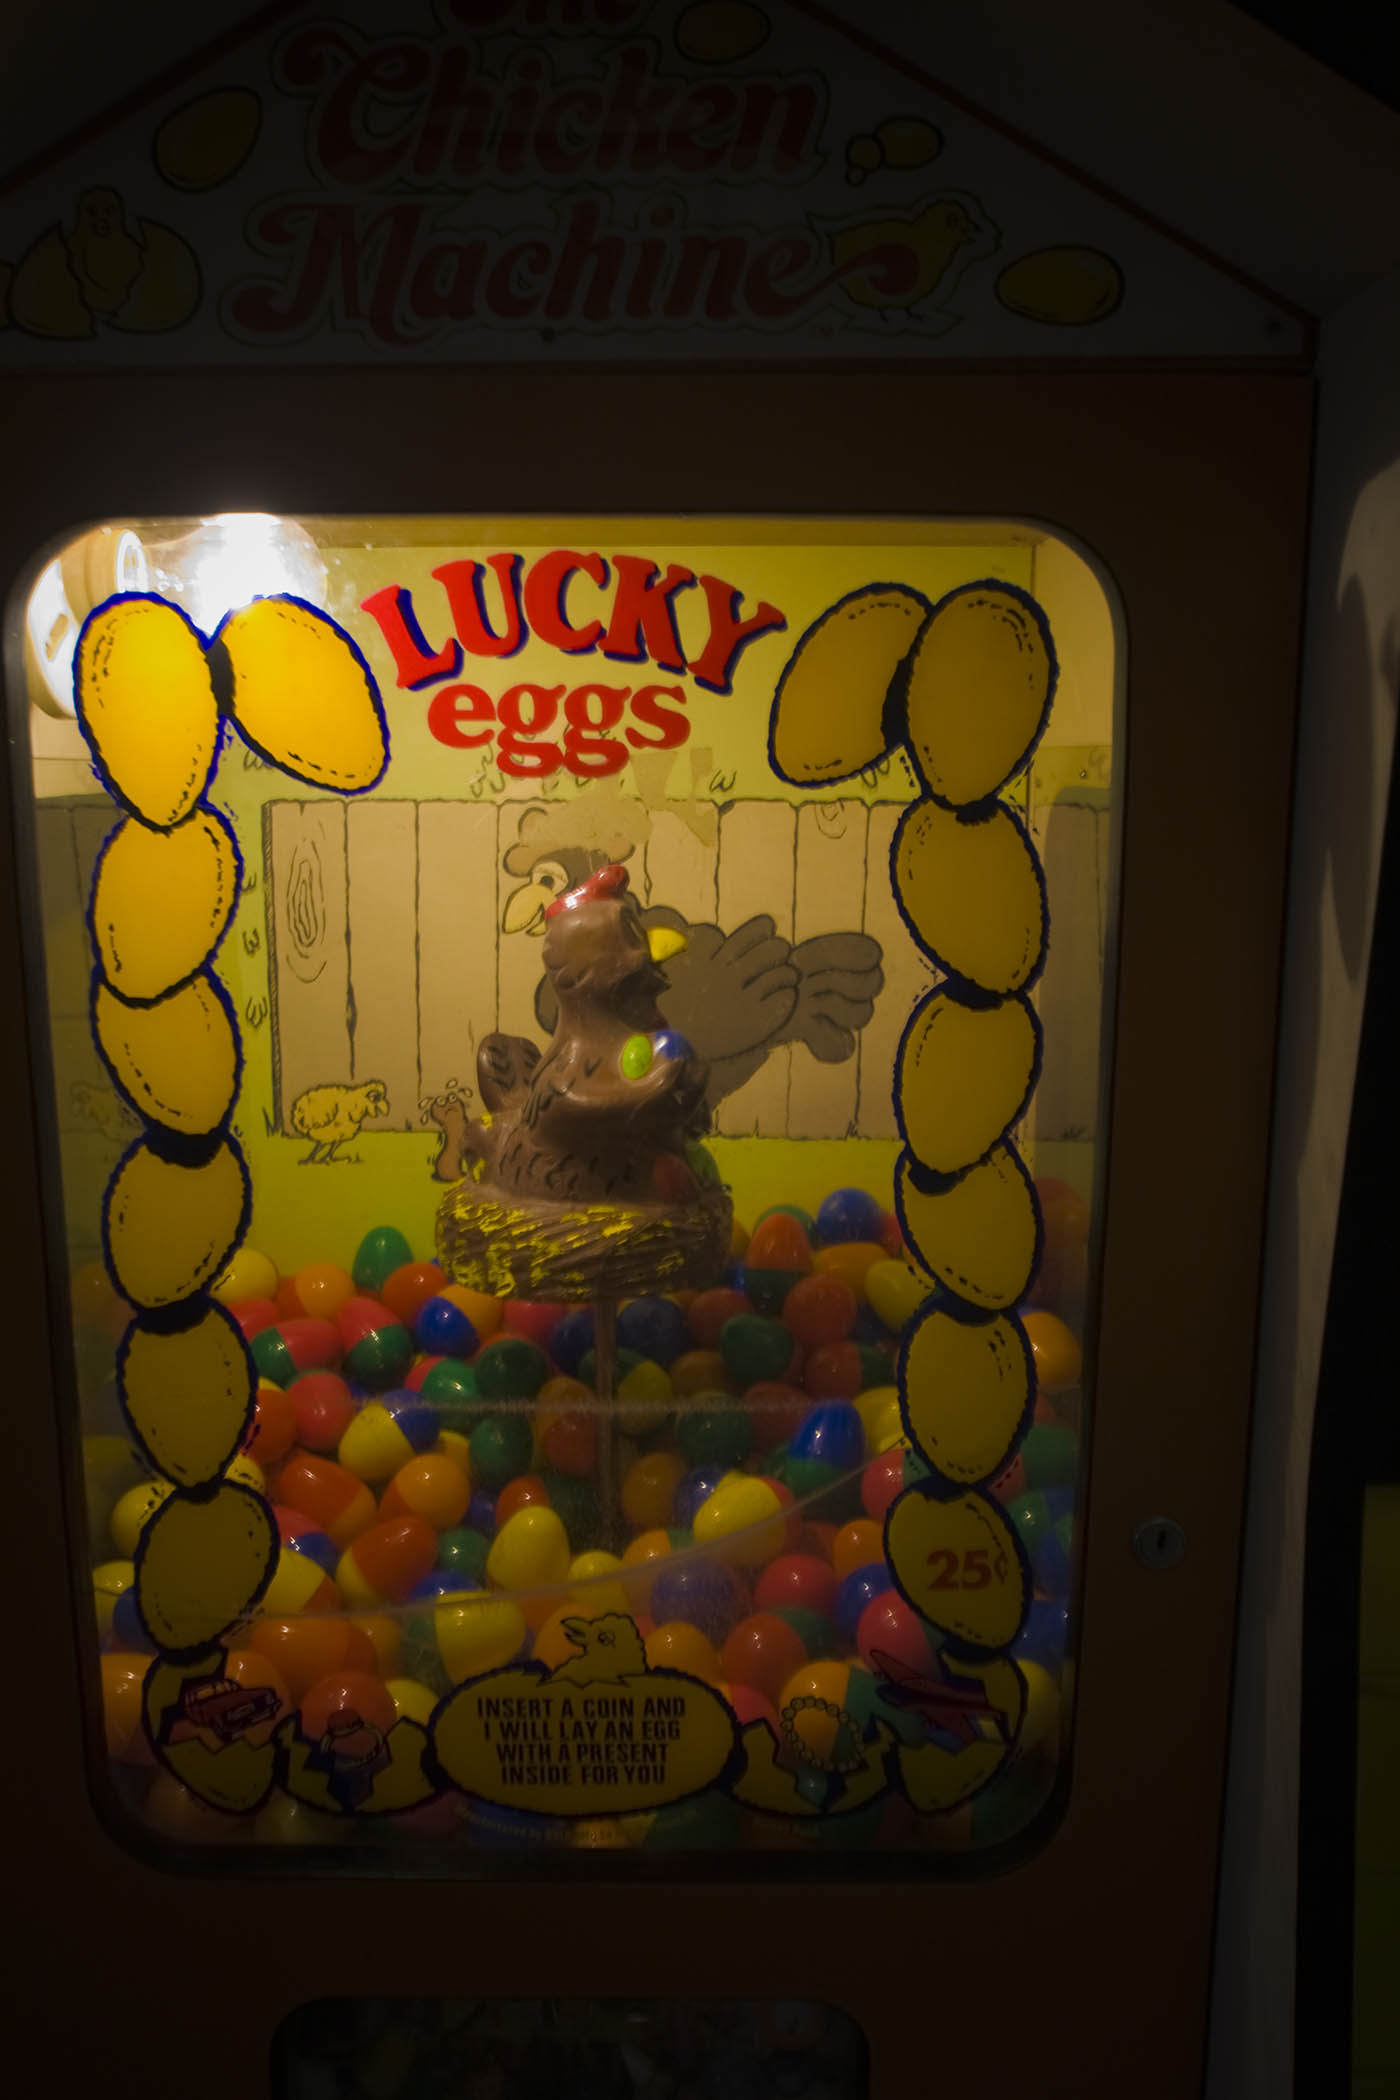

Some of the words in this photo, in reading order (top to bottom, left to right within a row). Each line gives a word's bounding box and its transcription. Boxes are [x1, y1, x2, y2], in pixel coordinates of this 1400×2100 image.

[282, 29, 818, 185] Chicken
[230, 199, 925, 347] Machine
[360, 549, 788, 695] LUCKY
[427, 684, 691, 778] eggs
[477, 1697, 552, 1718] INSERT
[560, 1697, 574, 1718] A
[583, 1697, 635, 1718] COIN
[642, 1698, 686, 1717] AND
[483, 1721, 492, 1741] I
[499, 1721, 553, 1741] WILL
[559, 1721, 598, 1741] LAY
[604, 1721, 634, 1740] AN
[641, 1721, 681, 1740] EGG
[496, 1743, 551, 1764] WITH
[557, 1743, 572, 1764] A
[576, 1743, 670, 1763] PRESENT
[501, 1765, 573, 1786] INSIDE
[580, 1765, 619, 1786] FOR
[623, 1765, 666, 1785] YOU
